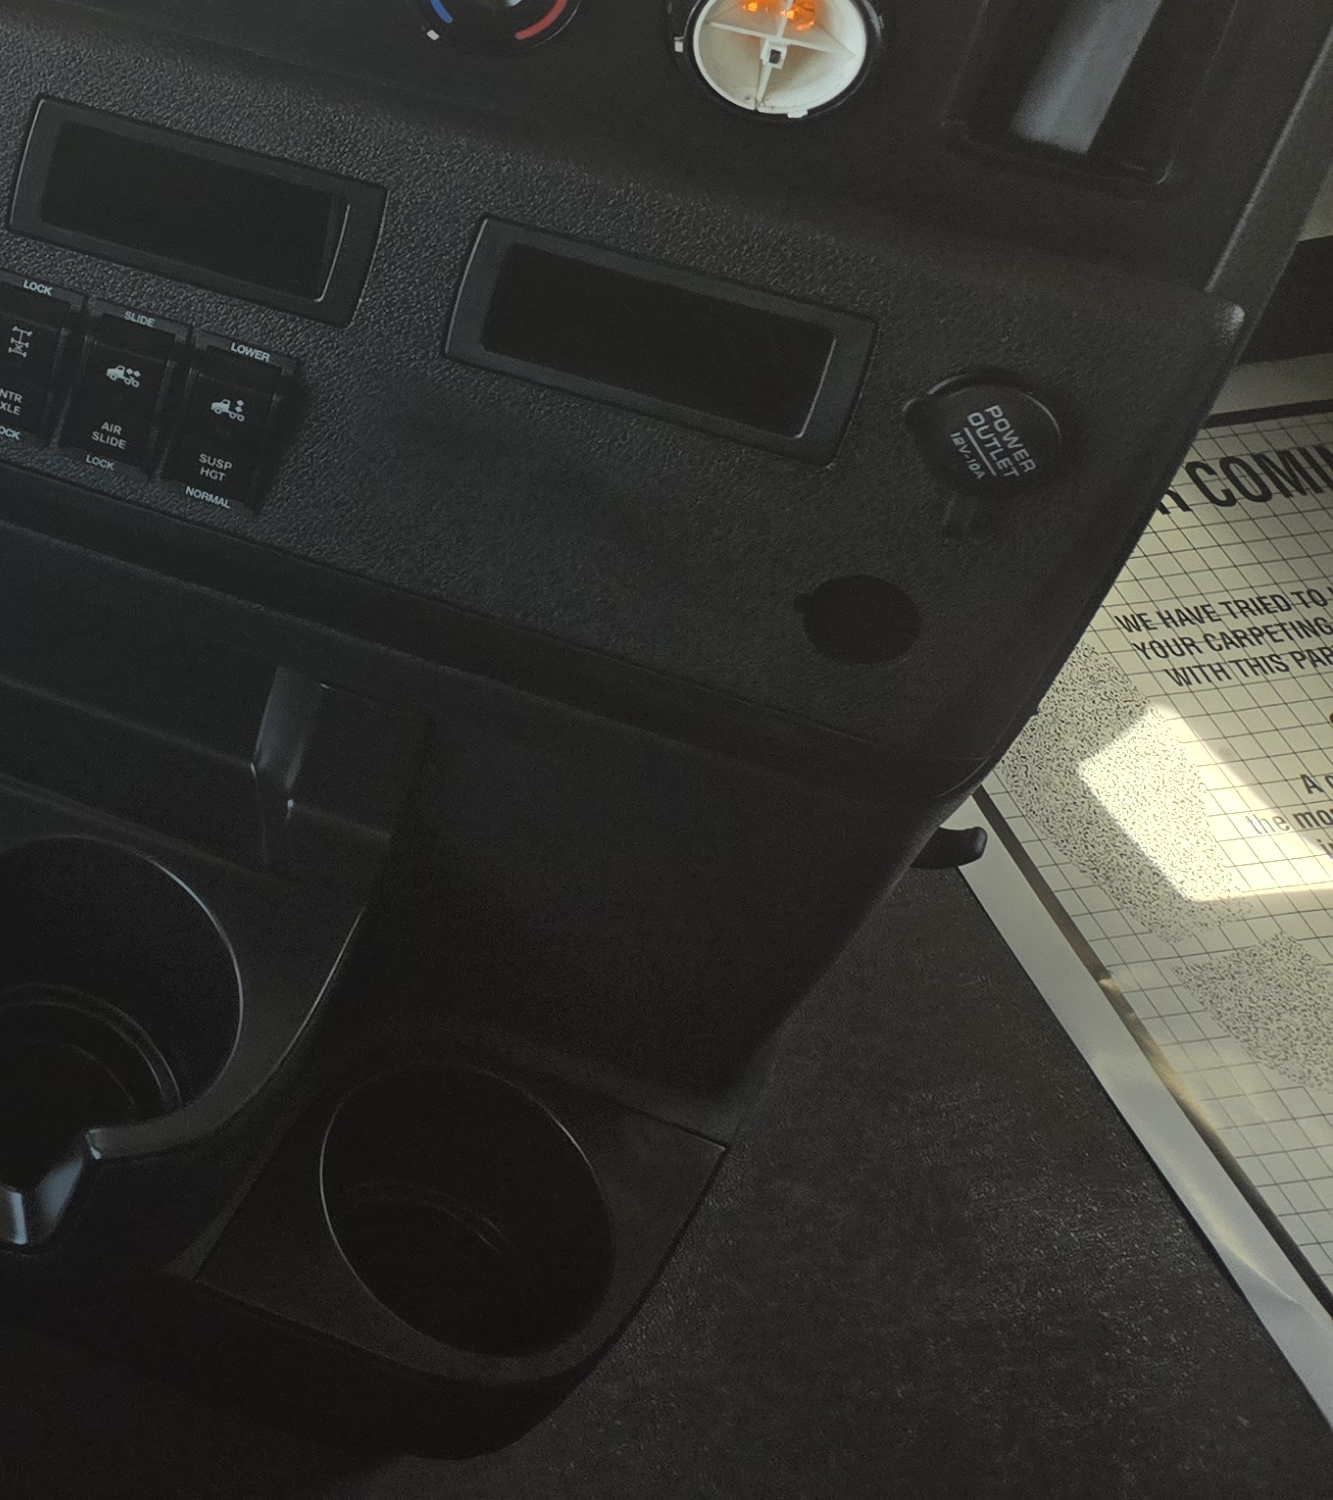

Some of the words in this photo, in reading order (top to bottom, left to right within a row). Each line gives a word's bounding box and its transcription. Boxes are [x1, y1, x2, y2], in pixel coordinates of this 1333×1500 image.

[23, 279, 53, 297] LOCK
[124, 310, 156, 328] SLIDE
[230, 342, 271, 364] LOWER
[100, 421, 123, 436] AIR
[984, 404, 1037, 473] POWER
[91, 431, 127, 450] SLIDE
[967, 411, 1020, 477] OUTLET
[85, 454, 115, 471] LOCK
[199, 453, 233, 471] SUSP
[199, 466, 226, 483] HGT
[185, 485, 232, 510] NORMAL
[1115, 612, 1159, 633] WE
[1156, 603, 1222, 629] HAVE
[1218, 594, 1293, 620] TRIED
[1290, 588, 1328, 609] TO
[1131, 636, 1204, 661] YOUR
[1203, 616, 1333, 651] CARPETING
[1164, 662, 1232, 688] WITH
[1228, 653, 1290, 678] THIS
[1245, 813, 1290, 835] the
